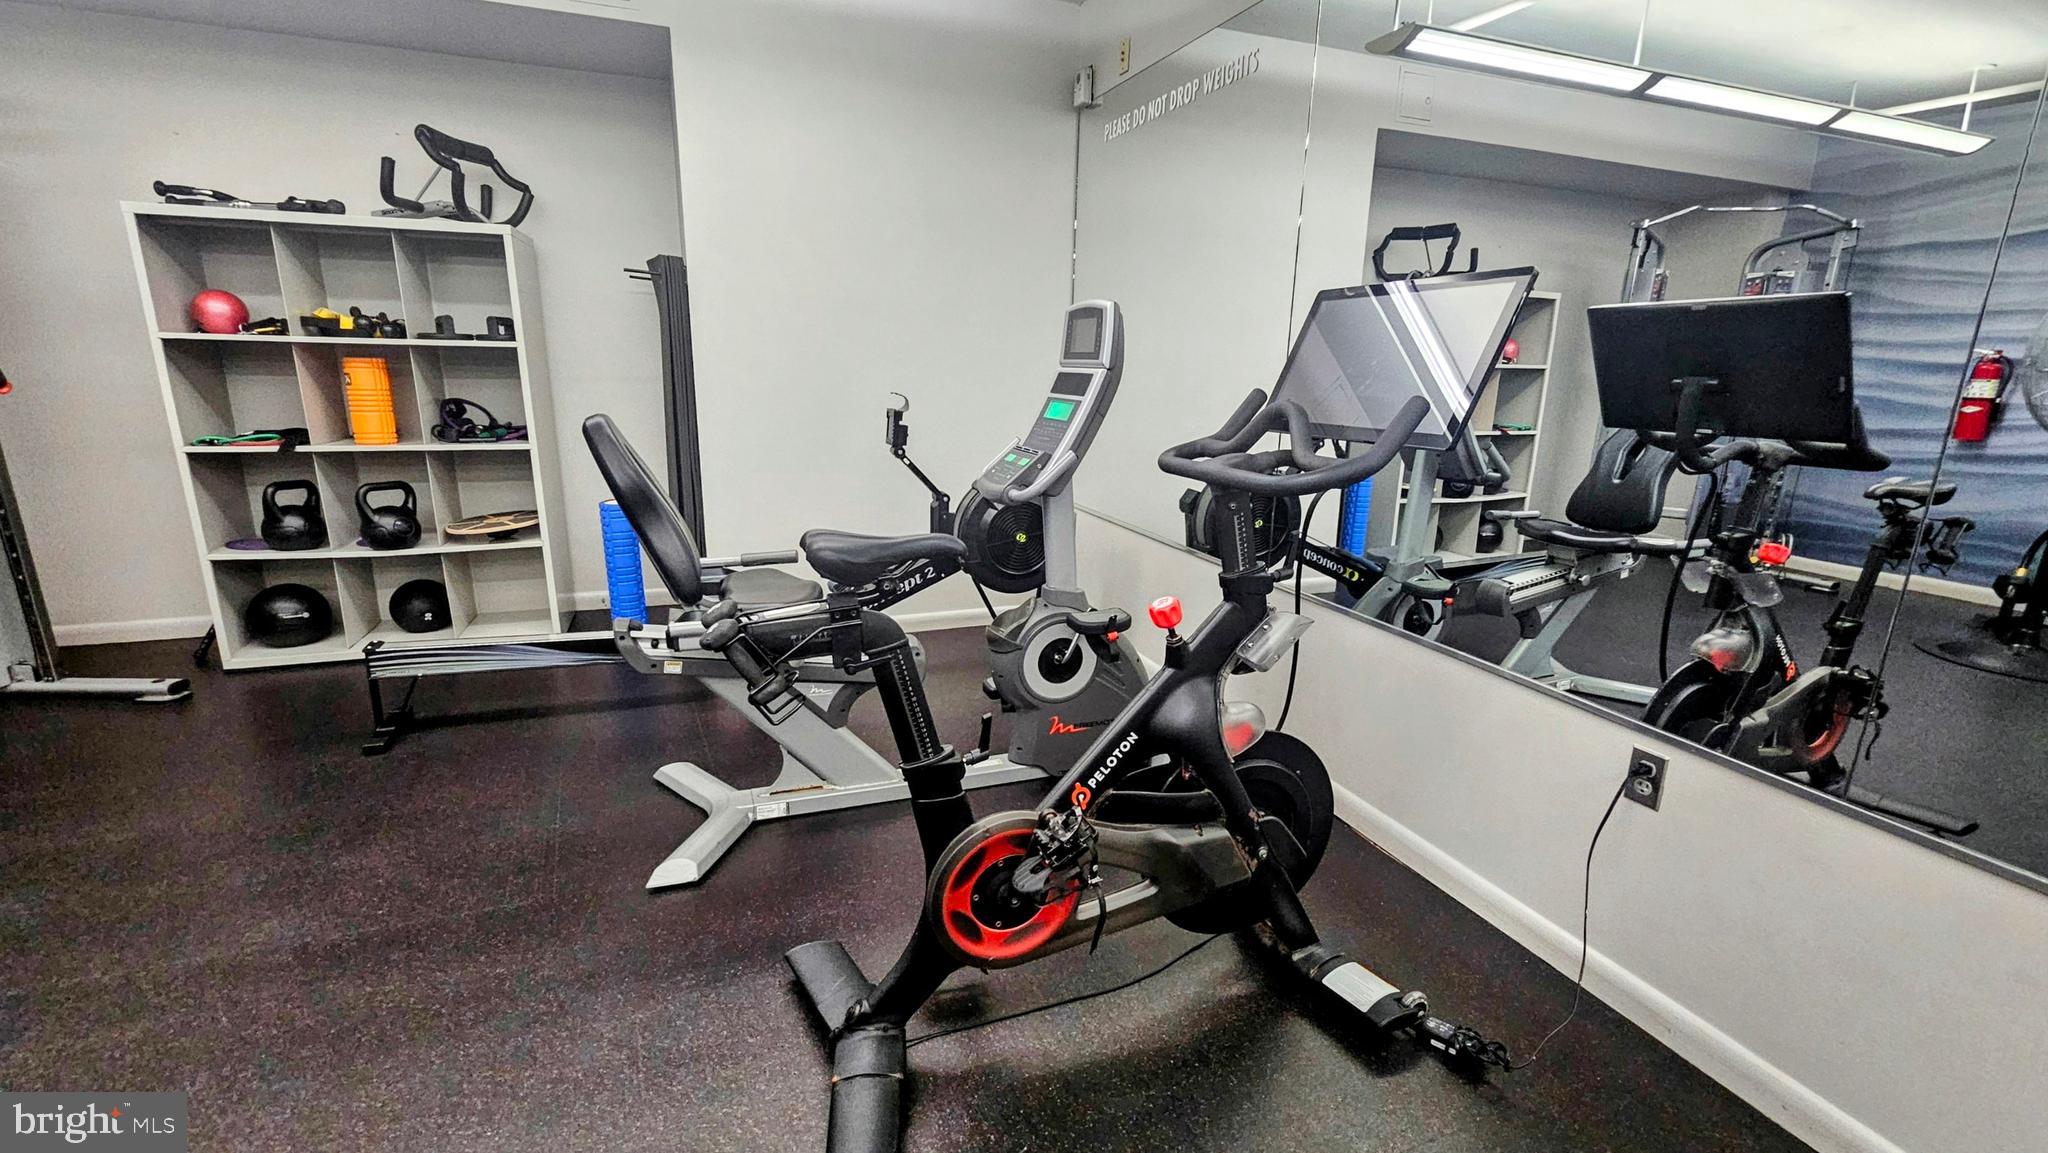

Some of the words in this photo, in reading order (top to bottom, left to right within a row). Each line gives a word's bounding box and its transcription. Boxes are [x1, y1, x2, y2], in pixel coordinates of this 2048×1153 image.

[1104, 113, 1131, 142] PLEASE
[1133, 105, 1146, 129] DO
[1148, 94, 1168, 121] NOT
[1169, 78, 1200, 111] DROP
[1203, 48, 1260, 96] WEIGHTS
[1087, 731, 1139, 789] PELOTON
